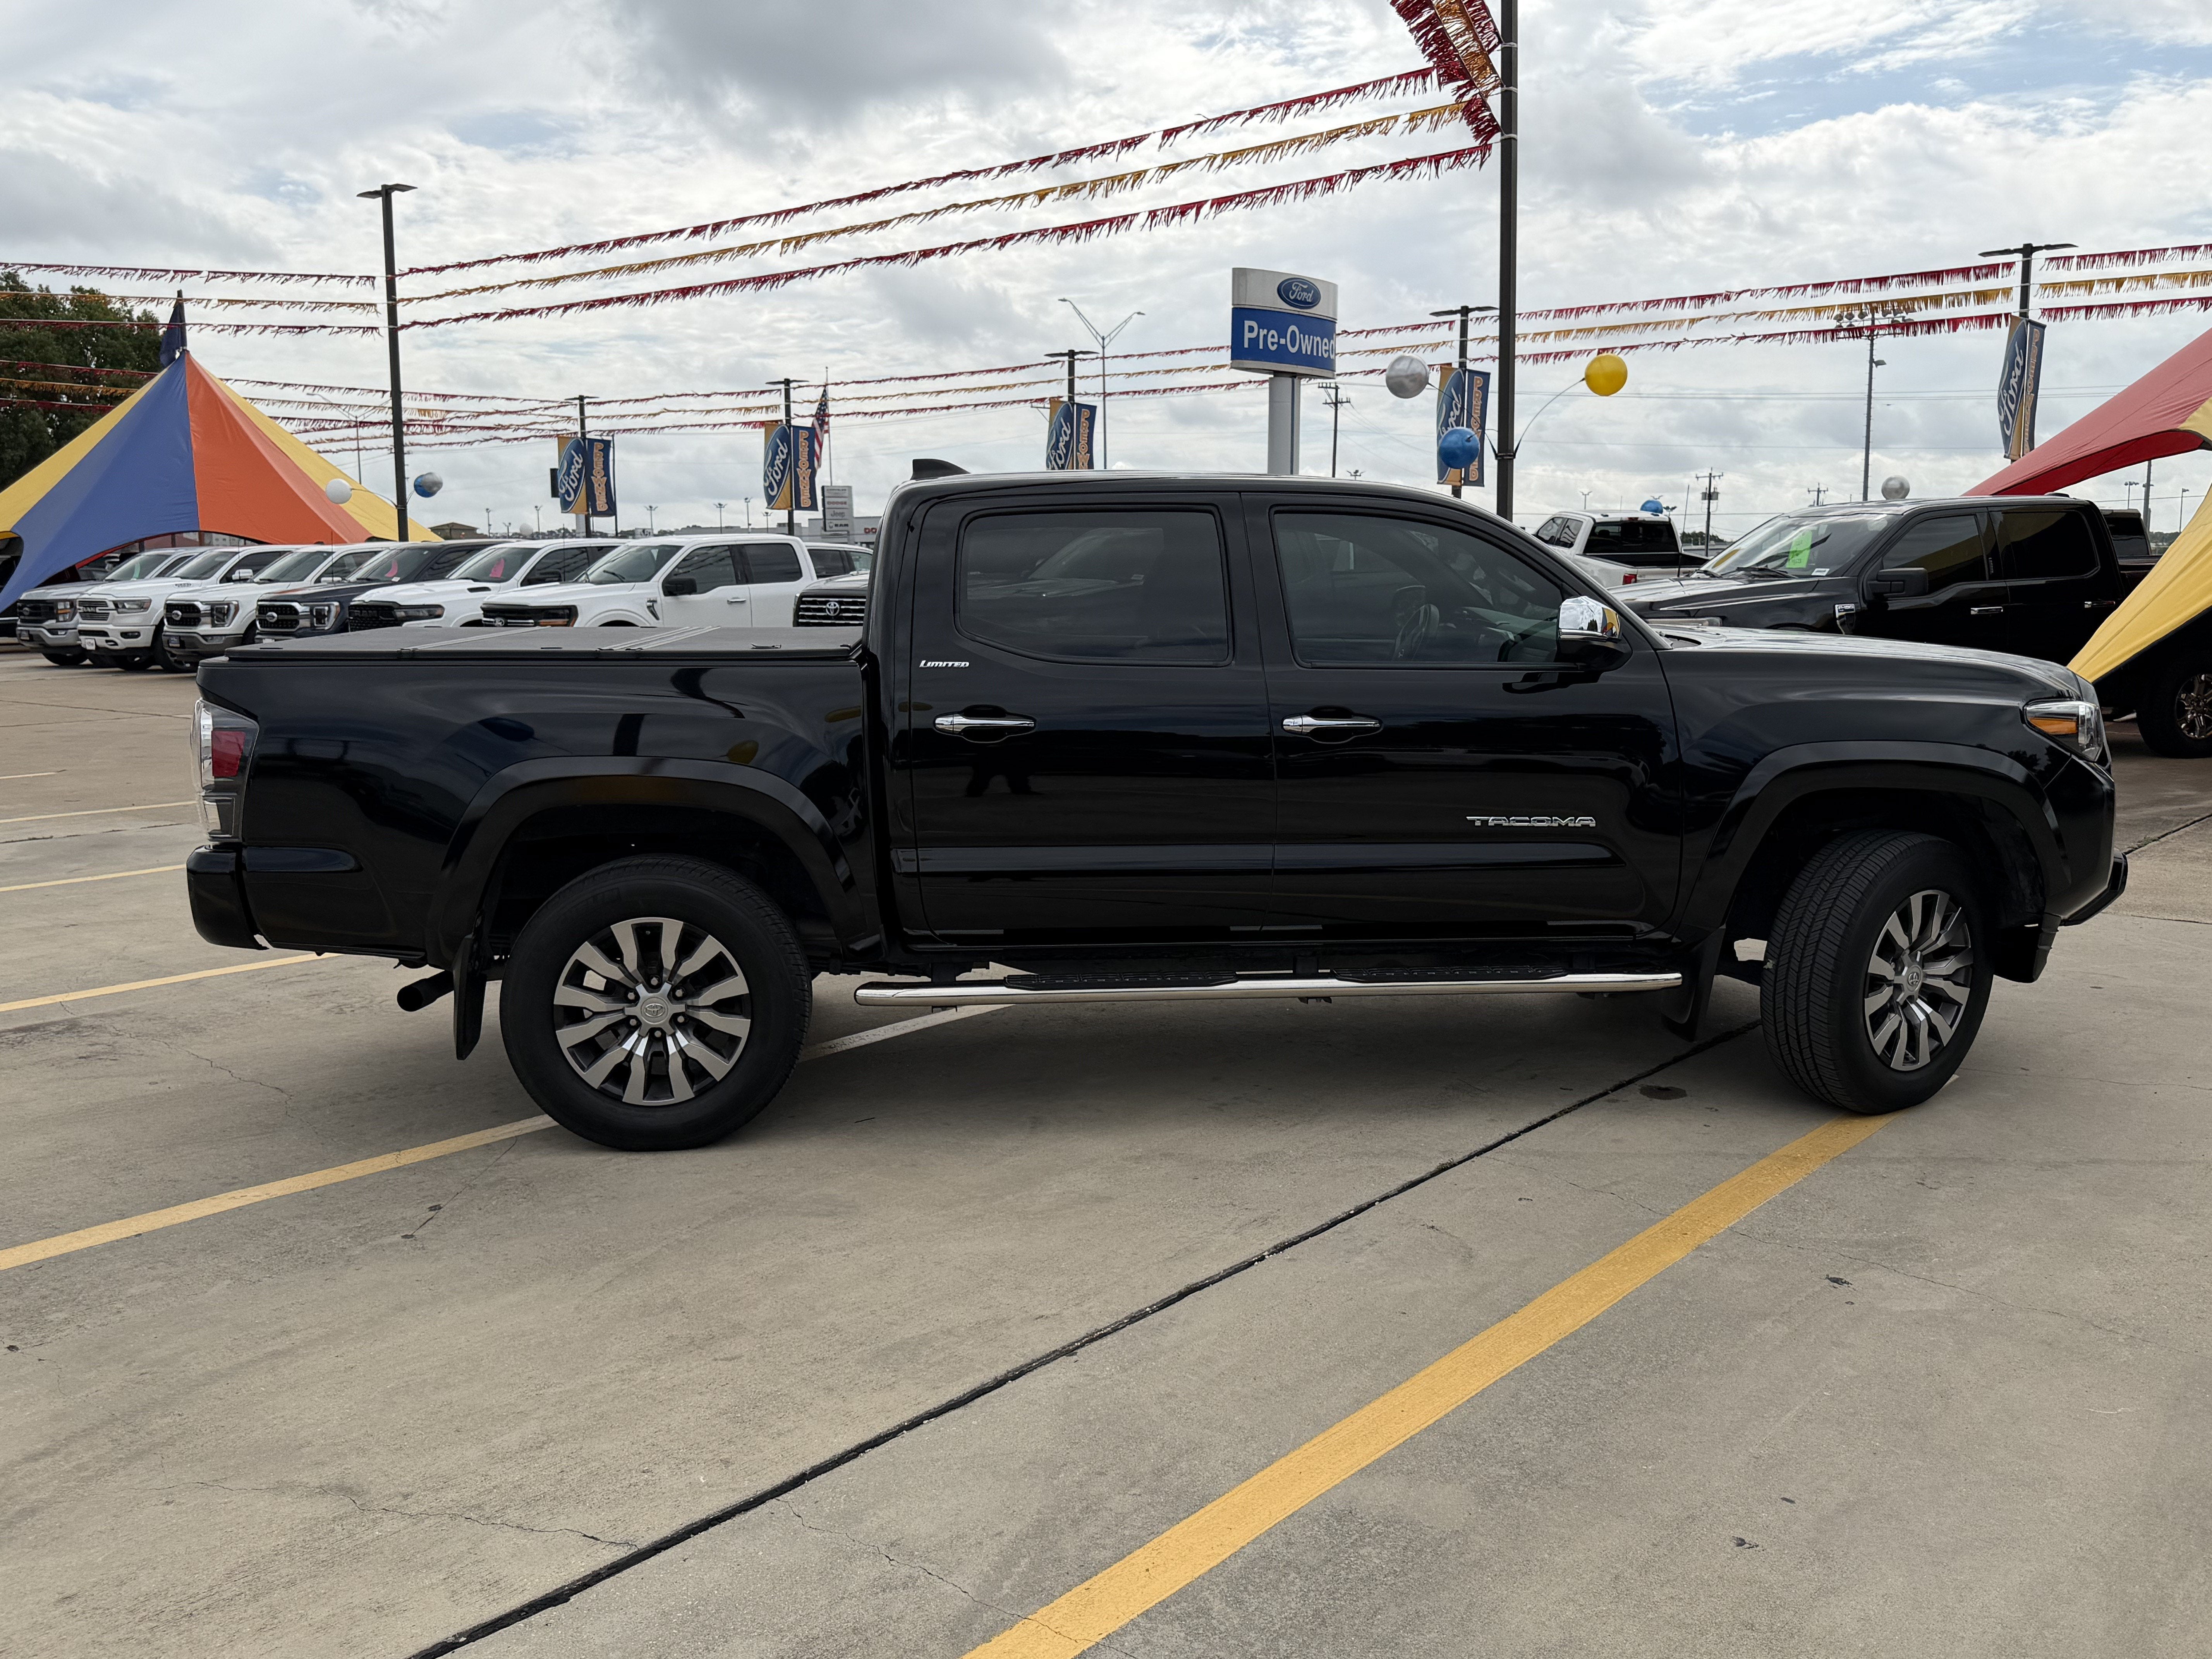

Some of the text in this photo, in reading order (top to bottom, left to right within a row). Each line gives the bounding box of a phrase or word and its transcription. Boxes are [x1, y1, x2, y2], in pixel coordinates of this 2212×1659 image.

[1289, 282, 1314, 302] Ford
[1244, 320, 1336, 359] Pre-Owned
[1998, 341, 2024, 436] Ford
[559, 450, 583, 501] Ford
[764, 438, 788, 496] Ford
[1466, 816, 1596, 827] TACOMA
